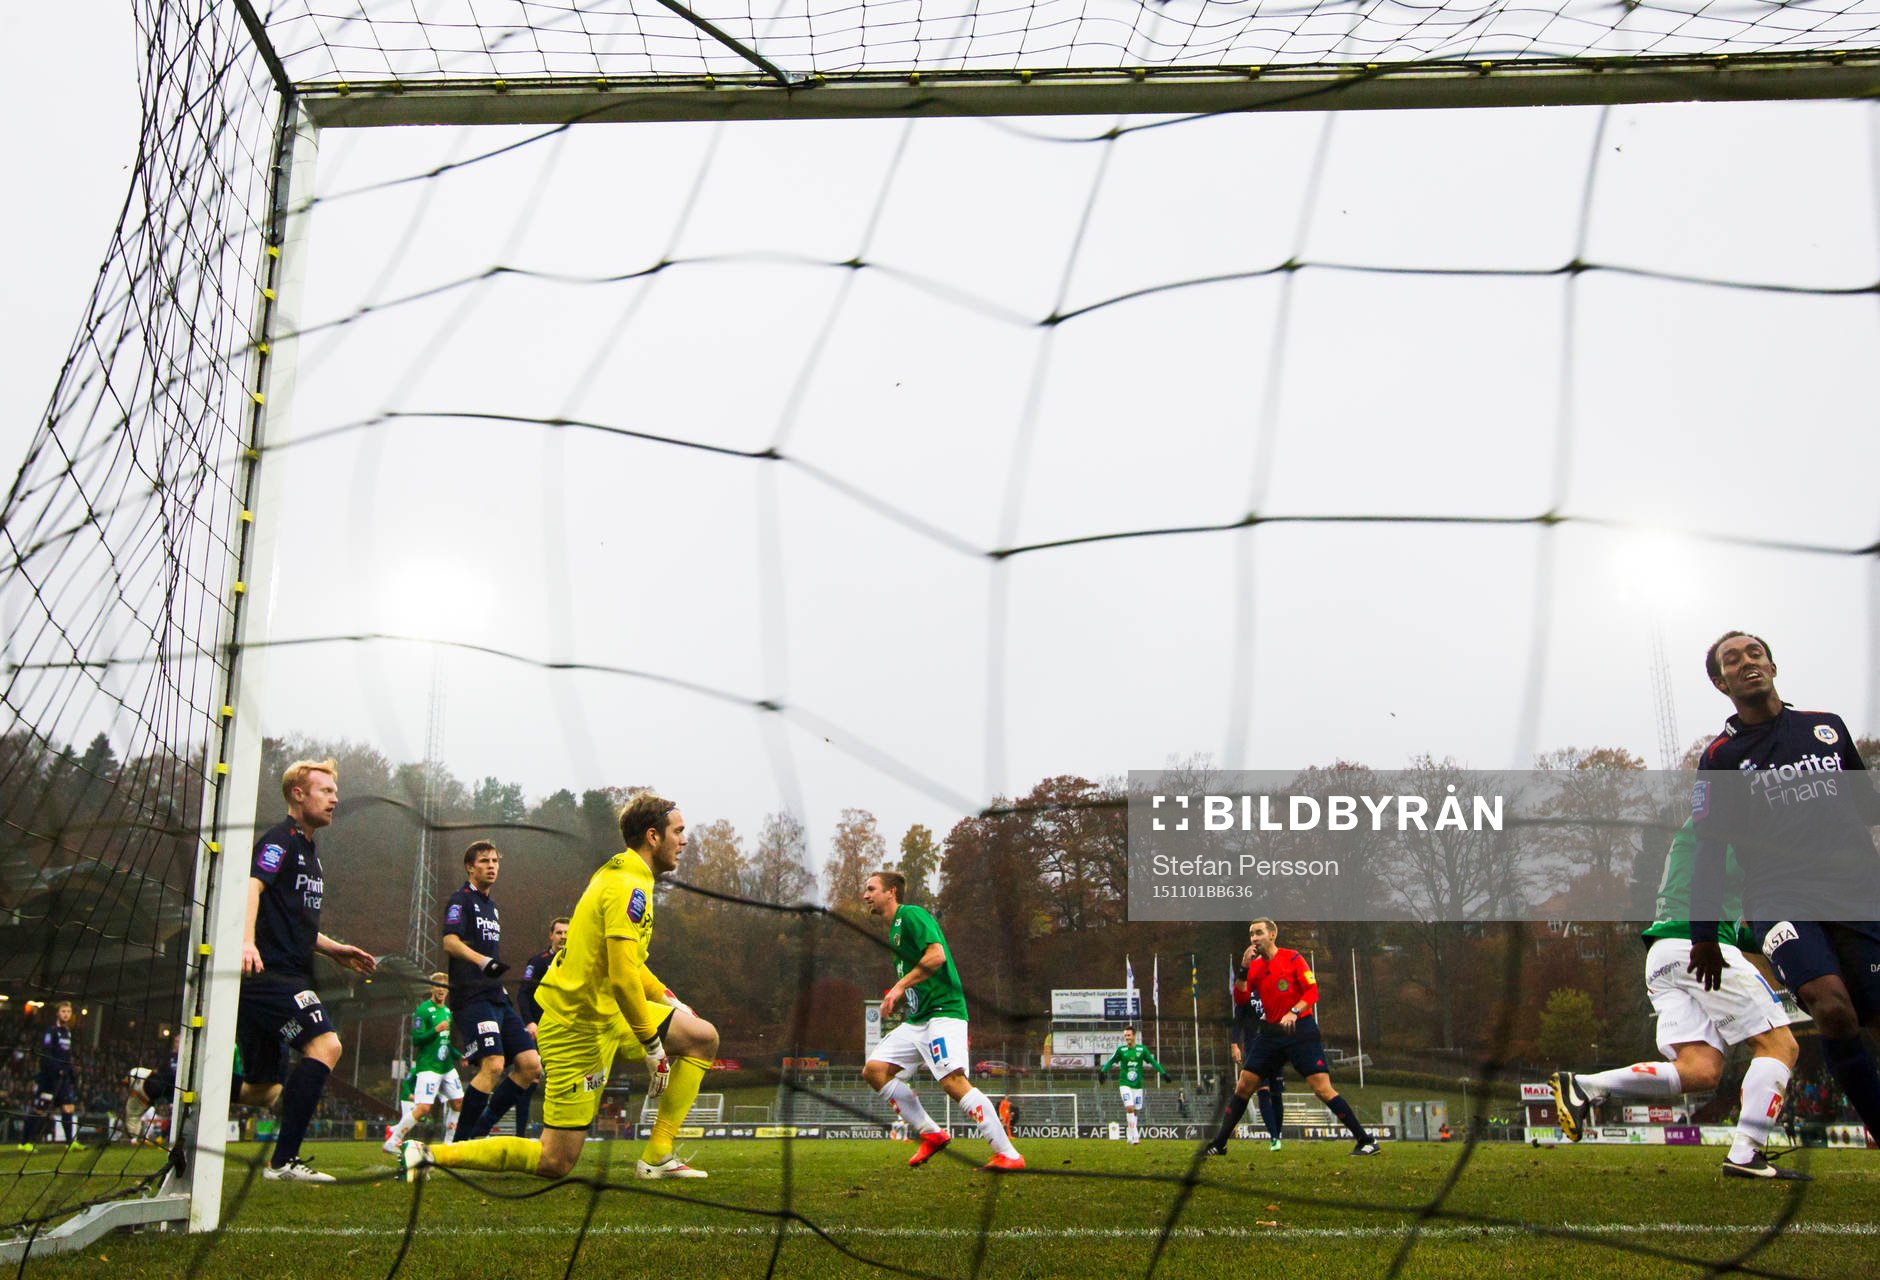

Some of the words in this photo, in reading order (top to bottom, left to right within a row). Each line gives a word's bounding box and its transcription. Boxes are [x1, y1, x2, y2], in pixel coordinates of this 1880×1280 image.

[1750, 752, 1843, 796] Prioritet
[1764, 778, 1838, 809] Finans
[309, 1009, 324, 1024] 17
[484, 1037, 495, 1047] 25
[572, 1082, 577, 1093] 1
[1523, 1086, 1549, 1096] MAXI
[825, 1129, 850, 1140] JOHN
[852, 1130, 883, 1139] BAUER
[1305, 1128, 1318, 1138] IT
[1319, 1128, 1338, 1138] TILL
